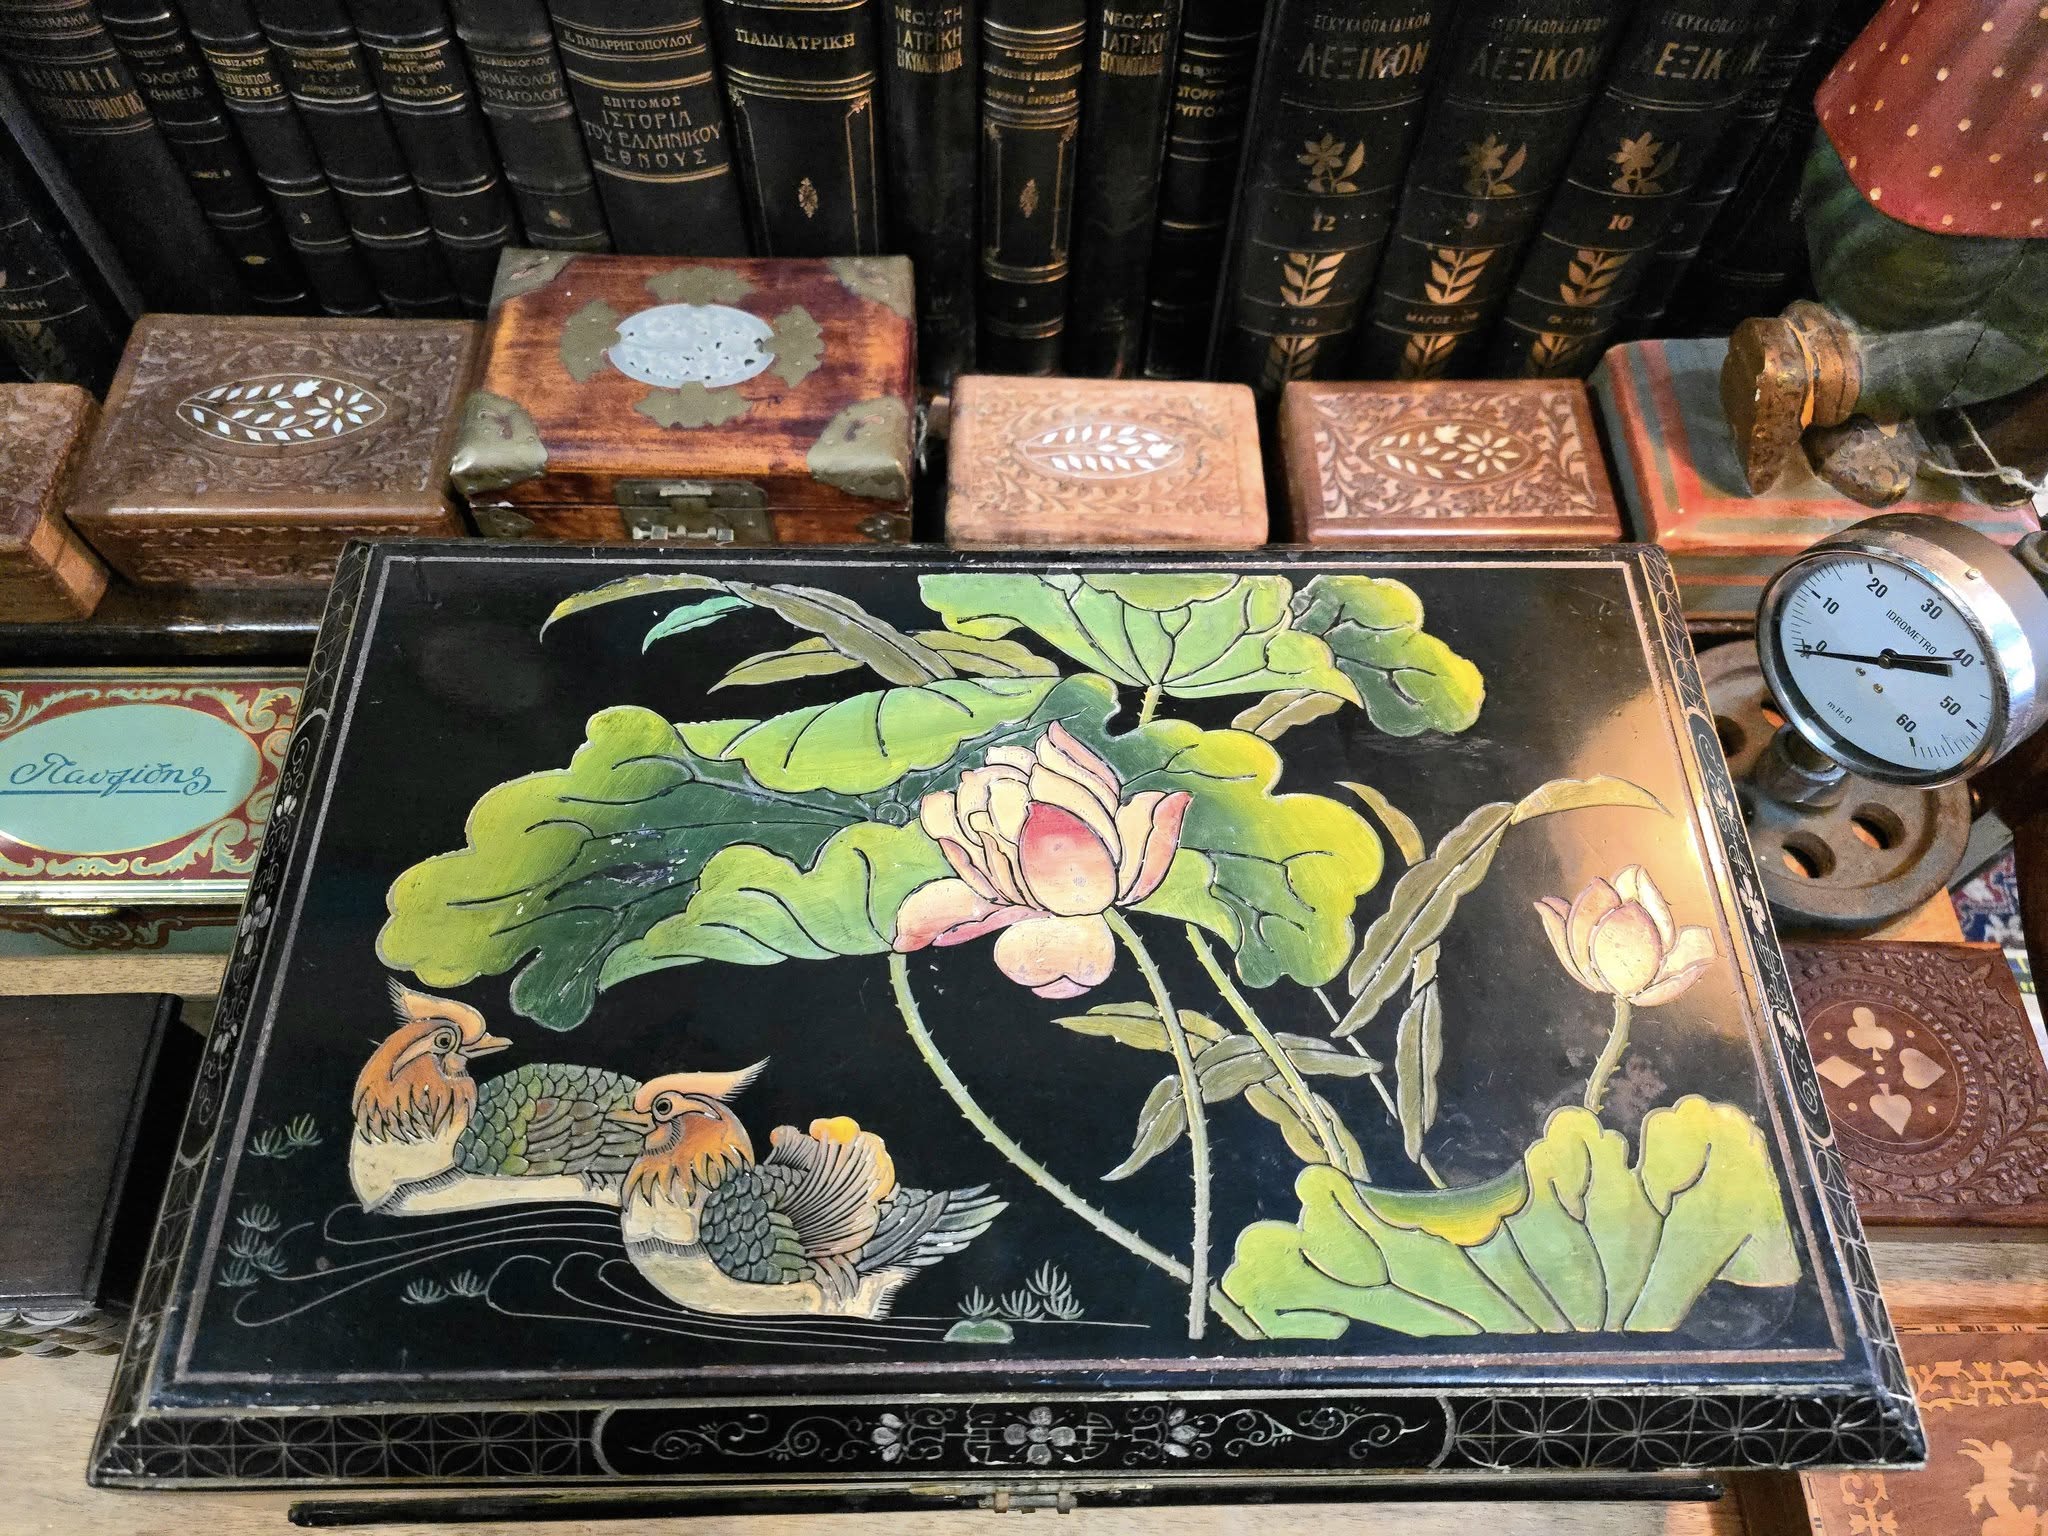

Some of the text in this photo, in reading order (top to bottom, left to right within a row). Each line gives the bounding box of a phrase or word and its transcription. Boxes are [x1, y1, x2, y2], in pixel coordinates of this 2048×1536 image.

[735, 28, 856, 50] ΠΑΙΔΙΑΤΡΙΚΗ
[1298, 39, 1432, 80] ΛΕΞΙΚΟΝ
[603, 96, 681, 109] ΕΠΙΤΟΜΟΣ
[618, 121, 723, 150] ΕΛΛΗΝΙΚΟΥ
[604, 149, 707, 168] ΕΘΝΟΥΣ
[1311, 211, 1337, 231] 12
[1607, 213, 1634, 231] 10
[1866, 577, 1888, 598] 20
[1822, 597, 1840, 615] 10
[1920, 598, 1943, 620] 30
[1886, 609, 1938, 655] IDROMETRO
[1815, 640, 1828, 653] 0
[1952, 648, 1975, 668] 40
[1939, 695, 1962, 716] 50
[1896, 713, 1917, 733] 60
